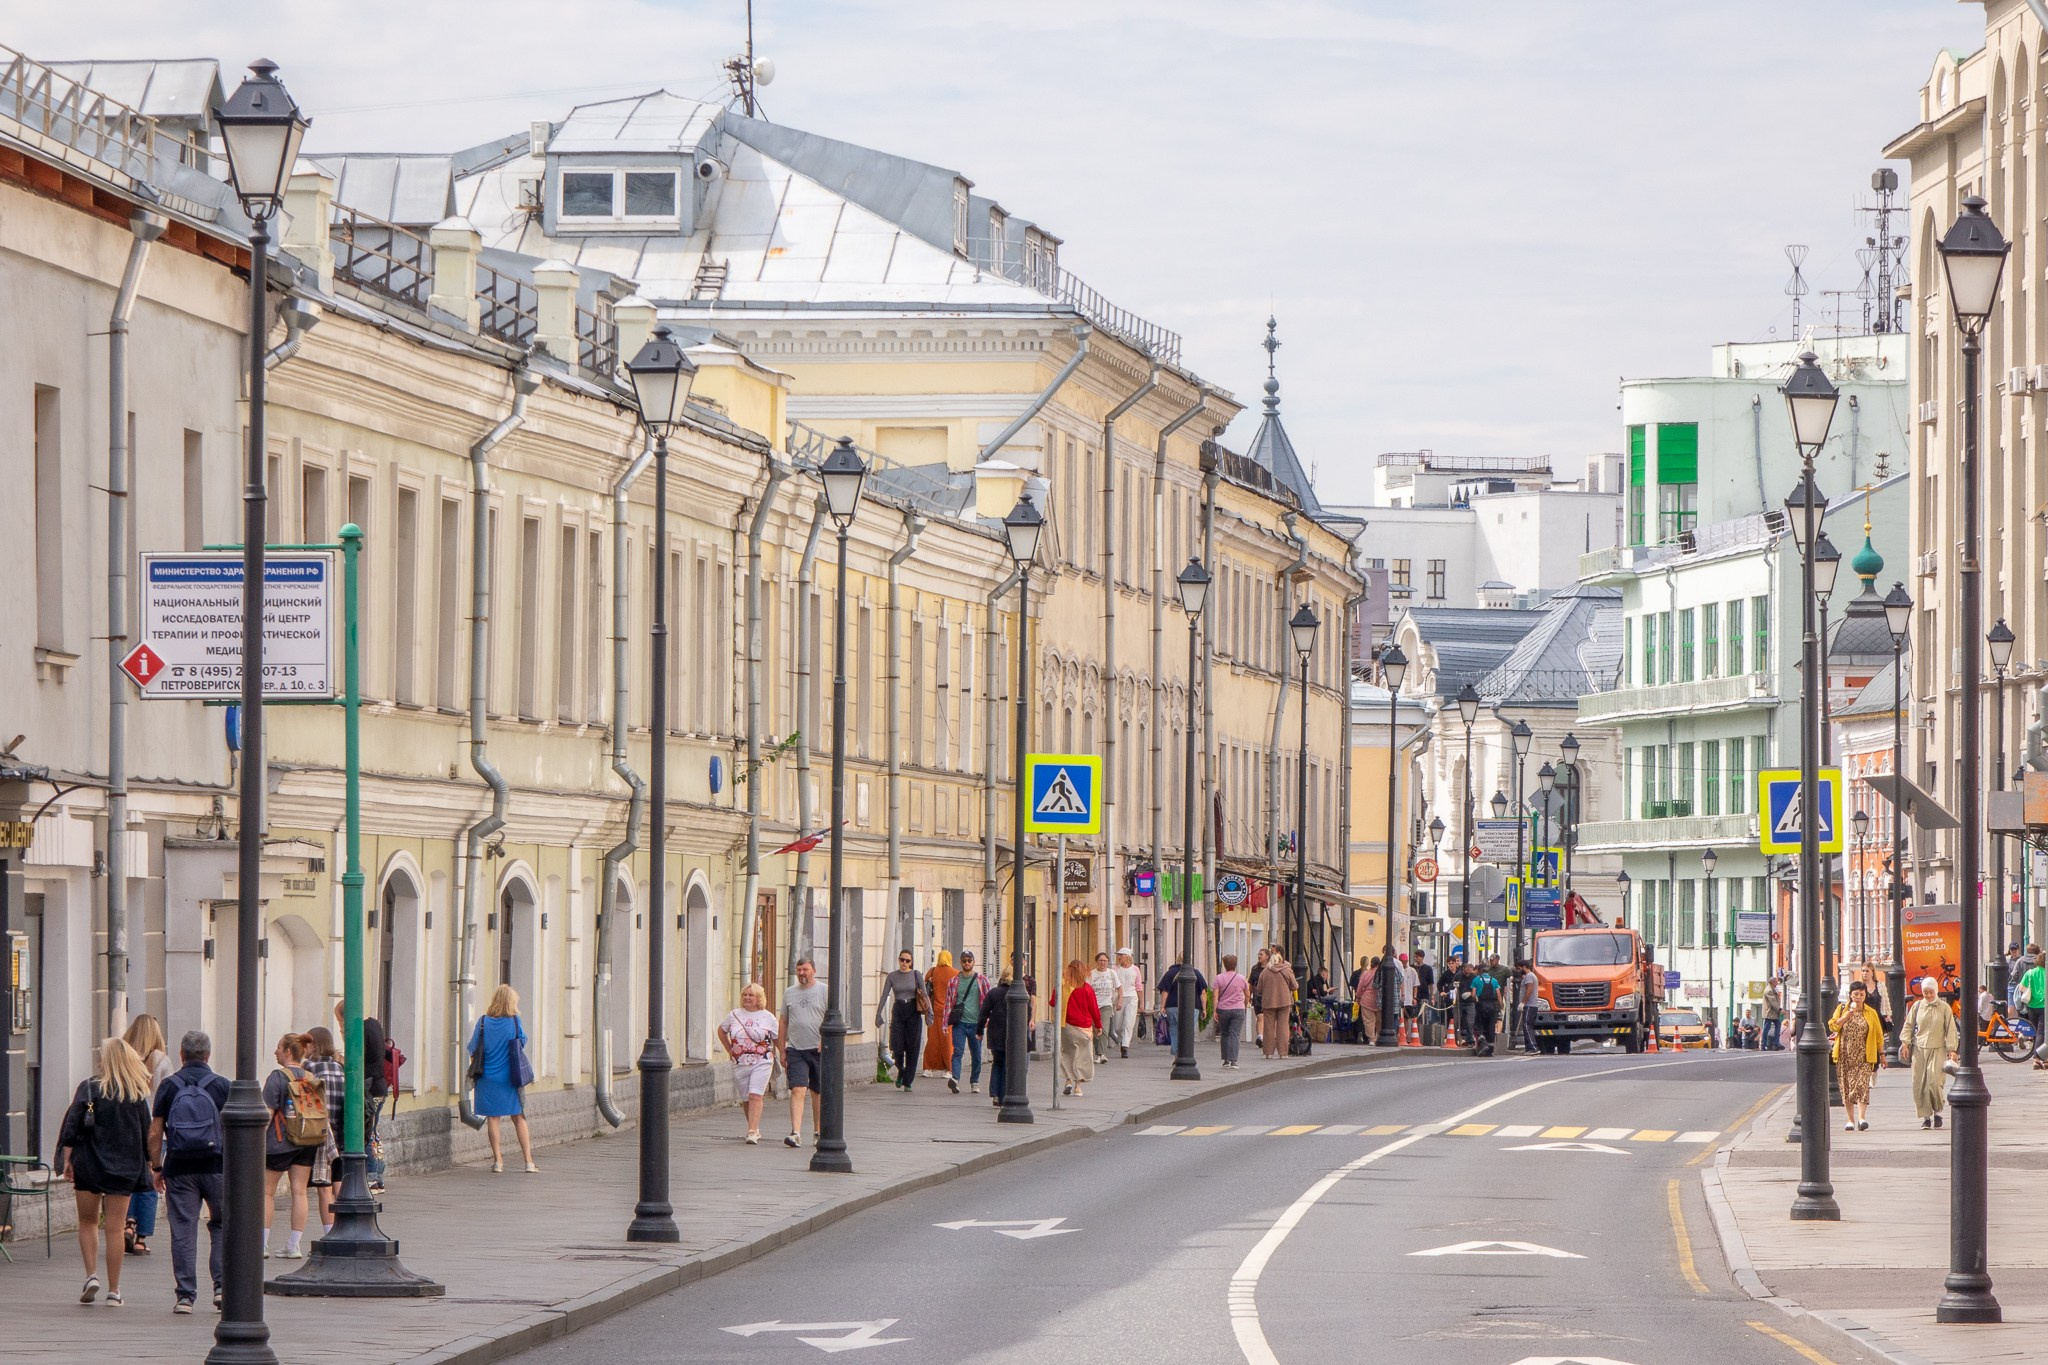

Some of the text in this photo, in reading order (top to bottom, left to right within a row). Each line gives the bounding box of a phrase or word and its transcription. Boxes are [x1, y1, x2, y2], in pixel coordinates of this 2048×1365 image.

[154, 567, 319, 576] МИНИСТЕРСТВО ЗДРАРАНЕНИЯ РФ
[153, 596, 322, 608] НАЦИОНАЛЬНЫЙ ИЦИНСКИЙ
[162, 612, 311, 624] ИССЛЕДОВАТЕЛИЙ ЦЕНТР
[152, 630, 198, 639] ТЕРАПИИ
[201, 630, 208, 639] И
[206, 646, 266, 656] МЕДИЦ
[190, 666, 198, 676] 8
[200, 666, 232, 678] (495)
[318, 680, 325, 690] 3
[12, 822, 34, 848] ЦЕНТР
